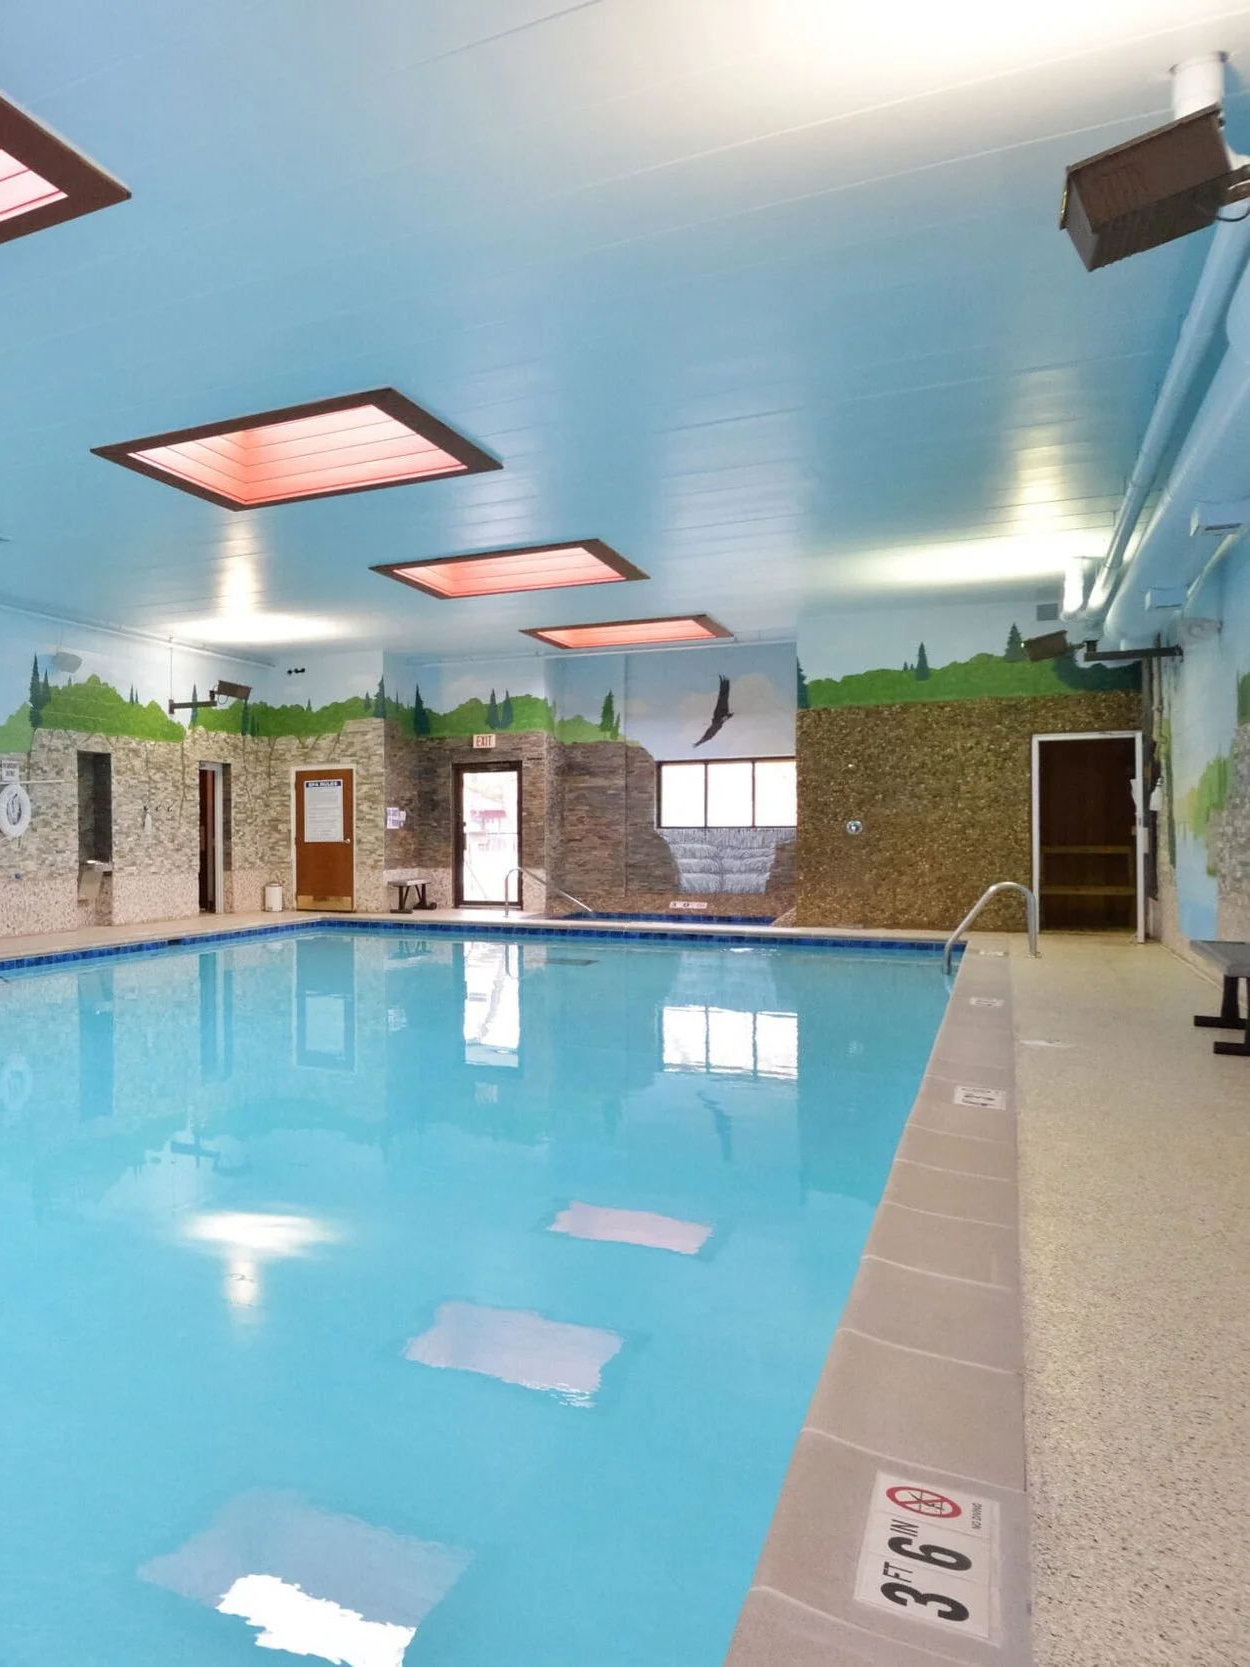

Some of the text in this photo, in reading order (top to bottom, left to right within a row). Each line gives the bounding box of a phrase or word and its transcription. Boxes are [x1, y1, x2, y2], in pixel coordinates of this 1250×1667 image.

[476, 735, 492, 747] EXIT
[880, 1518, 973, 1622] 3 FT 6 IN
